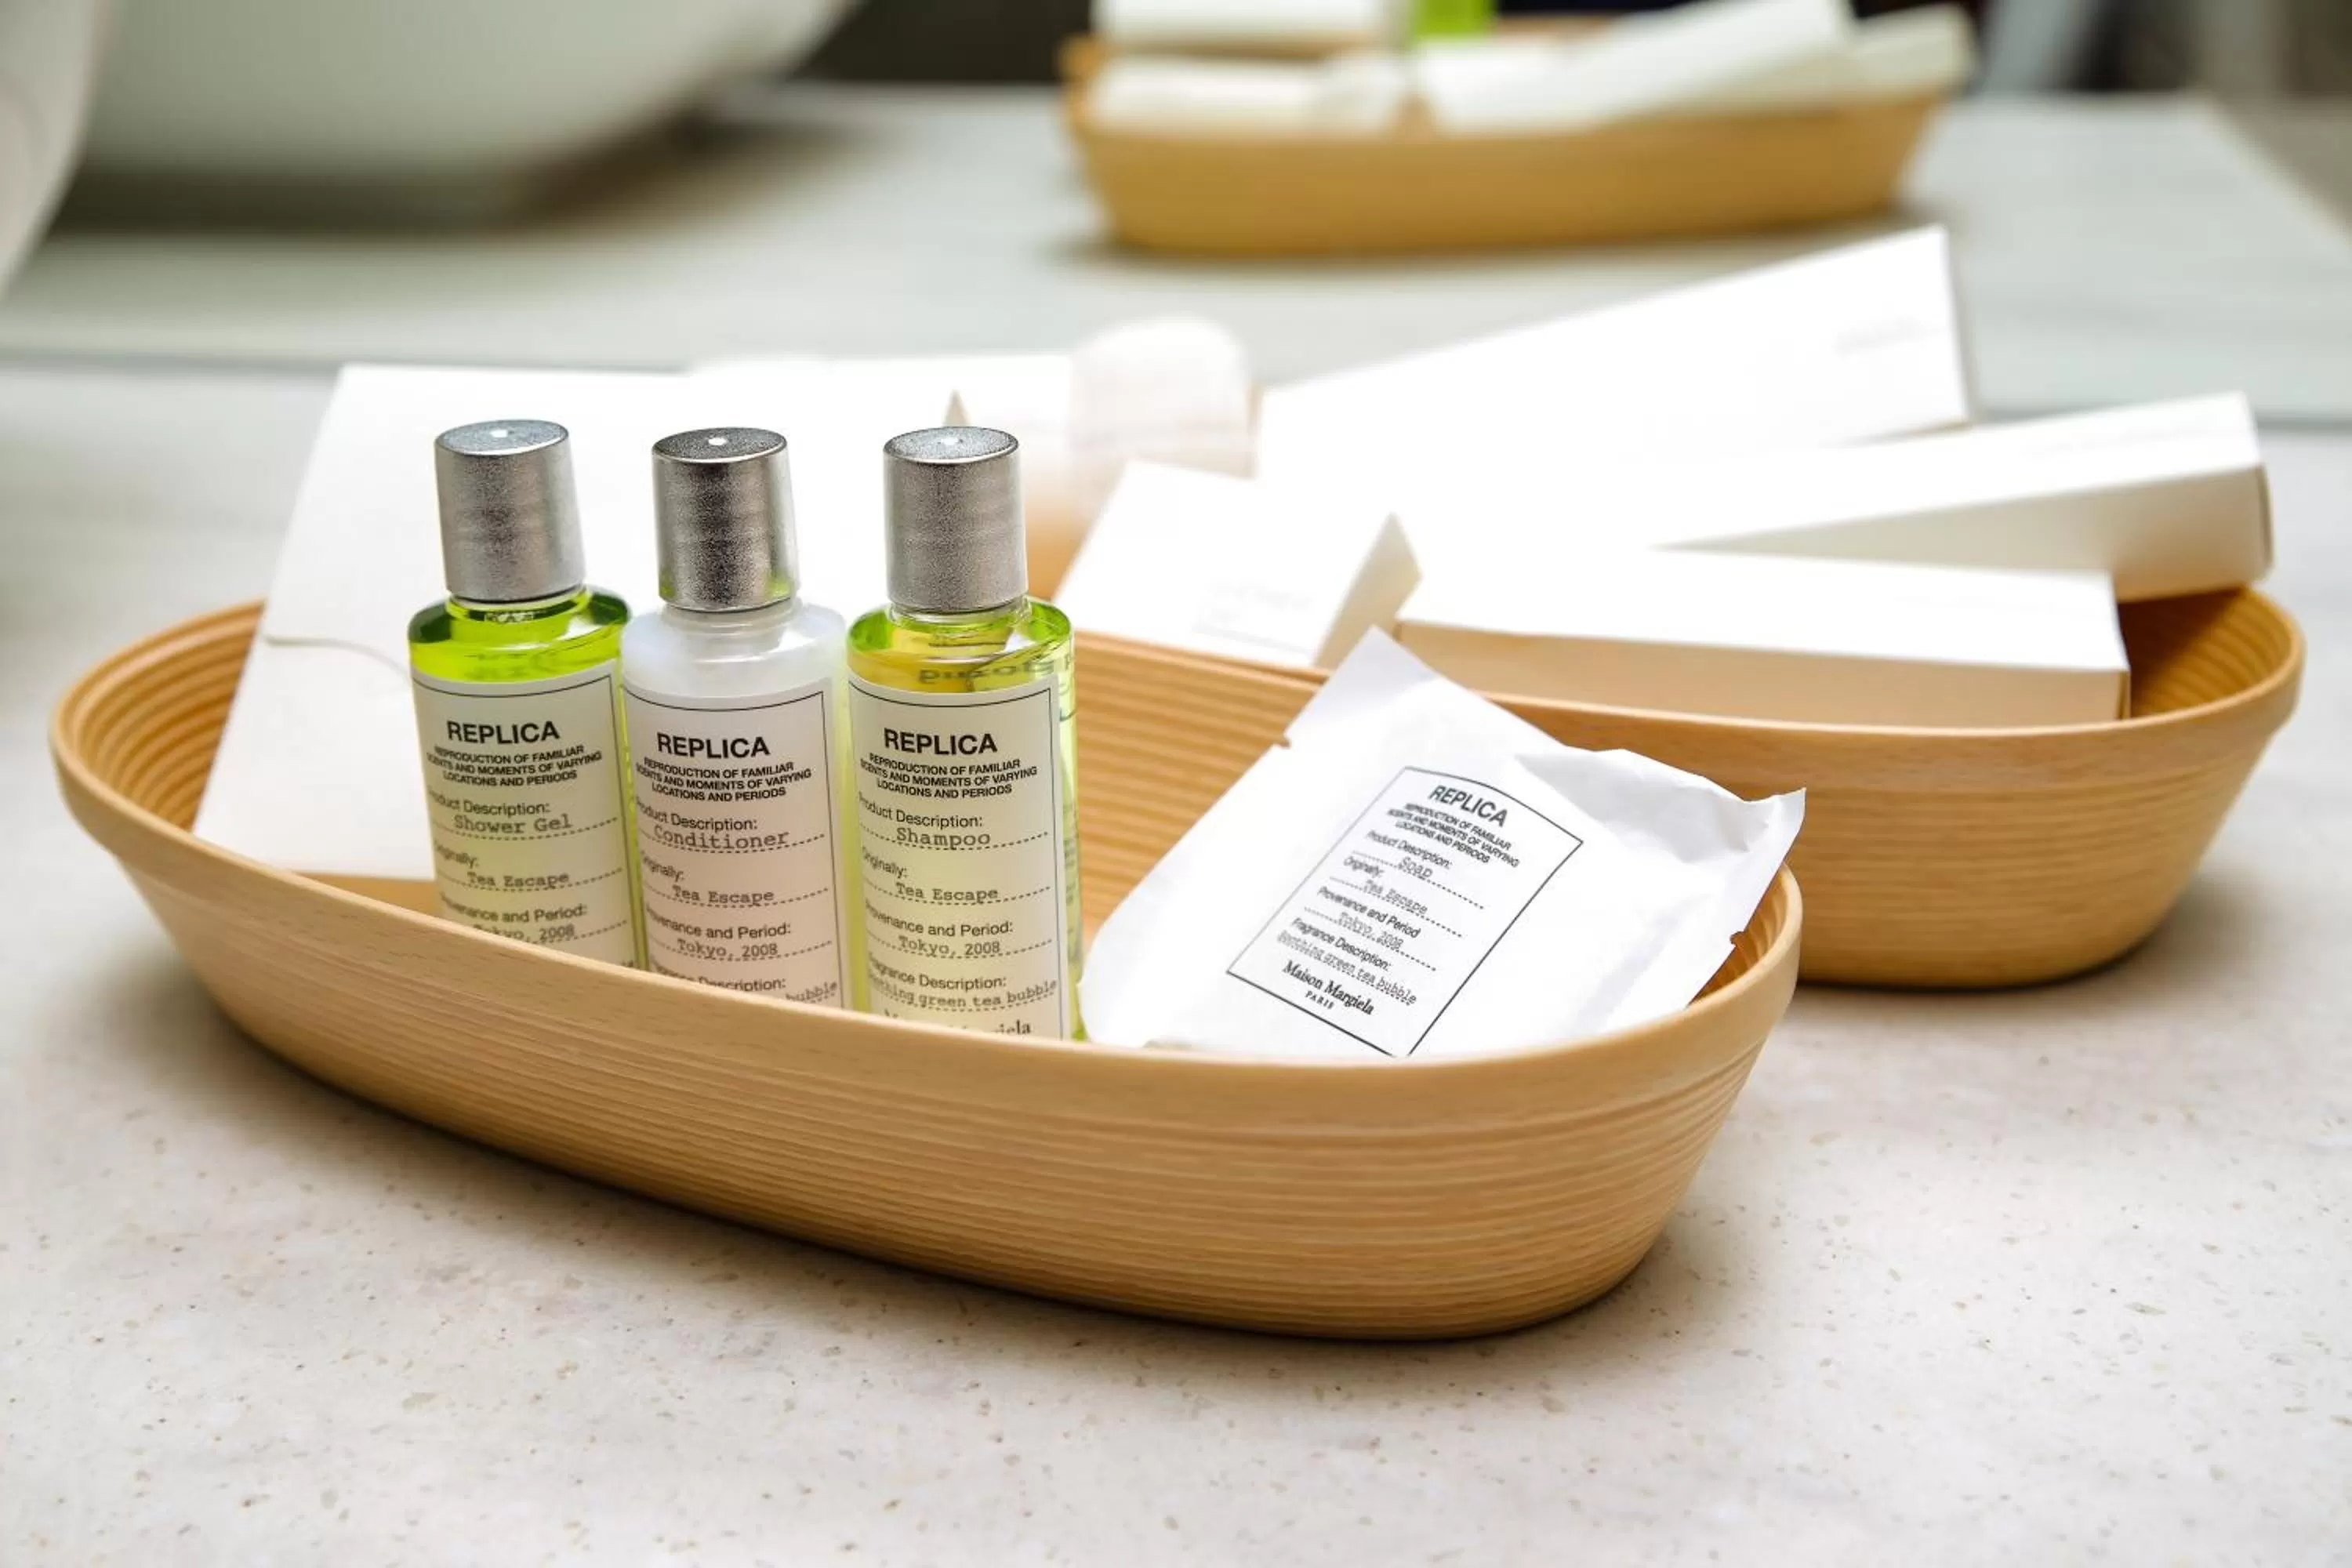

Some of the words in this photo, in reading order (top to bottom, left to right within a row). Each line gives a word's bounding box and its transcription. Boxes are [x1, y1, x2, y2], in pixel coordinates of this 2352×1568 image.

[447, 720, 561, 744] REPLICA
[884, 728, 998, 756] REPLICA
[514, 753, 528, 763] OF
[533, 745, 584, 762] FAMILIAR
[657, 731, 771, 759] REPLICA
[456, 763, 475, 774] AND
[477, 766, 535, 775] MOMENTS
[539, 761, 553, 773] OF
[557, 751, 602, 770] VARYING
[644, 757, 720, 779] REPRODUCTION
[723, 768, 738, 779] OF
[741, 762, 794, 778] FAMILIAR
[869, 753, 947, 775] REPRODUCTION
[950, 766, 966, 775] OF
[969, 758, 1021, 775] FAMILIAR
[443, 771, 497, 786] LOCATIONS
[499, 777, 524, 786] AND
[527, 770, 578, 785] PERIODS
[664, 775, 684, 787] AND
[687, 779, 744, 789] MOMENTS
[747, 778, 762, 789] OF
[765, 768, 811, 786] VARYING
[889, 771, 910, 783] AND
[913, 776, 971, 786] MOMENTS
[974, 775, 989, 786] OF
[993, 766, 1037, 784] VARYING
[652, 782, 705, 801] LOCATIONS
[707, 791, 733, 802] AND
[735, 787, 786, 801] PERIODS
[877, 778, 931, 798] LOCATIONS
[934, 788, 959, 799] AND
[962, 784, 1012, 798] PERIODS
[430, 789, 459, 810] duct
[464, 799, 550, 817] Description:
[1428, 785, 1508, 828] REPLICA
[453, 815, 525, 834] Shower
[534, 813, 572, 833] Gel
[671, 813, 757, 833] Description:
[896, 809, 982, 829] Description:
[654, 825, 789, 849] Conditioner
[896, 827, 991, 849] Shampoo
[1459, 821, 1472, 829] OF
[1471, 822, 1512, 851] FAMILIAR
[1452, 840, 1490, 863] PERIODS
[1468, 836, 1481, 845] OF
[1481, 842, 1520, 868] VARYING
[1399, 856, 1433, 880] Soap
[467, 871, 495, 887] Tea
[503, 873, 569, 889] Escape
[672, 884, 700, 902] Tea
[708, 890, 775, 906] Escape
[895, 882, 924, 898] Tea
[932, 888, 999, 904] Escape
[502, 909, 528, 923] and
[534, 904, 587, 922] Period:
[1367, 908, 1388, 923] and
[539, 924, 575, 941] 2008
[706, 925, 733, 939] and
[739, 923, 791, 939] Period:
[928, 924, 956, 937] and
[960, 920, 1013, 937] Period:
[677, 938, 733, 960] Tokyo,
[742, 943, 778, 958] 2008
[898, 936, 956, 957] Tokyo,
[965, 941, 1000, 956] 2008
[1334, 937, 1392, 971] Description:
[919, 994, 966, 1008] green
[973, 995, 1001, 1006] tea
[1007, 980, 1057, 1003] bubble
[920, 974, 1007, 992] Description:
[1283, 960, 1323, 990] Maison
[1323, 980, 1374, 1015] Margiela
[1375, 978, 1417, 1005] bubble
[1305, 989, 1336, 1010] PARIS
